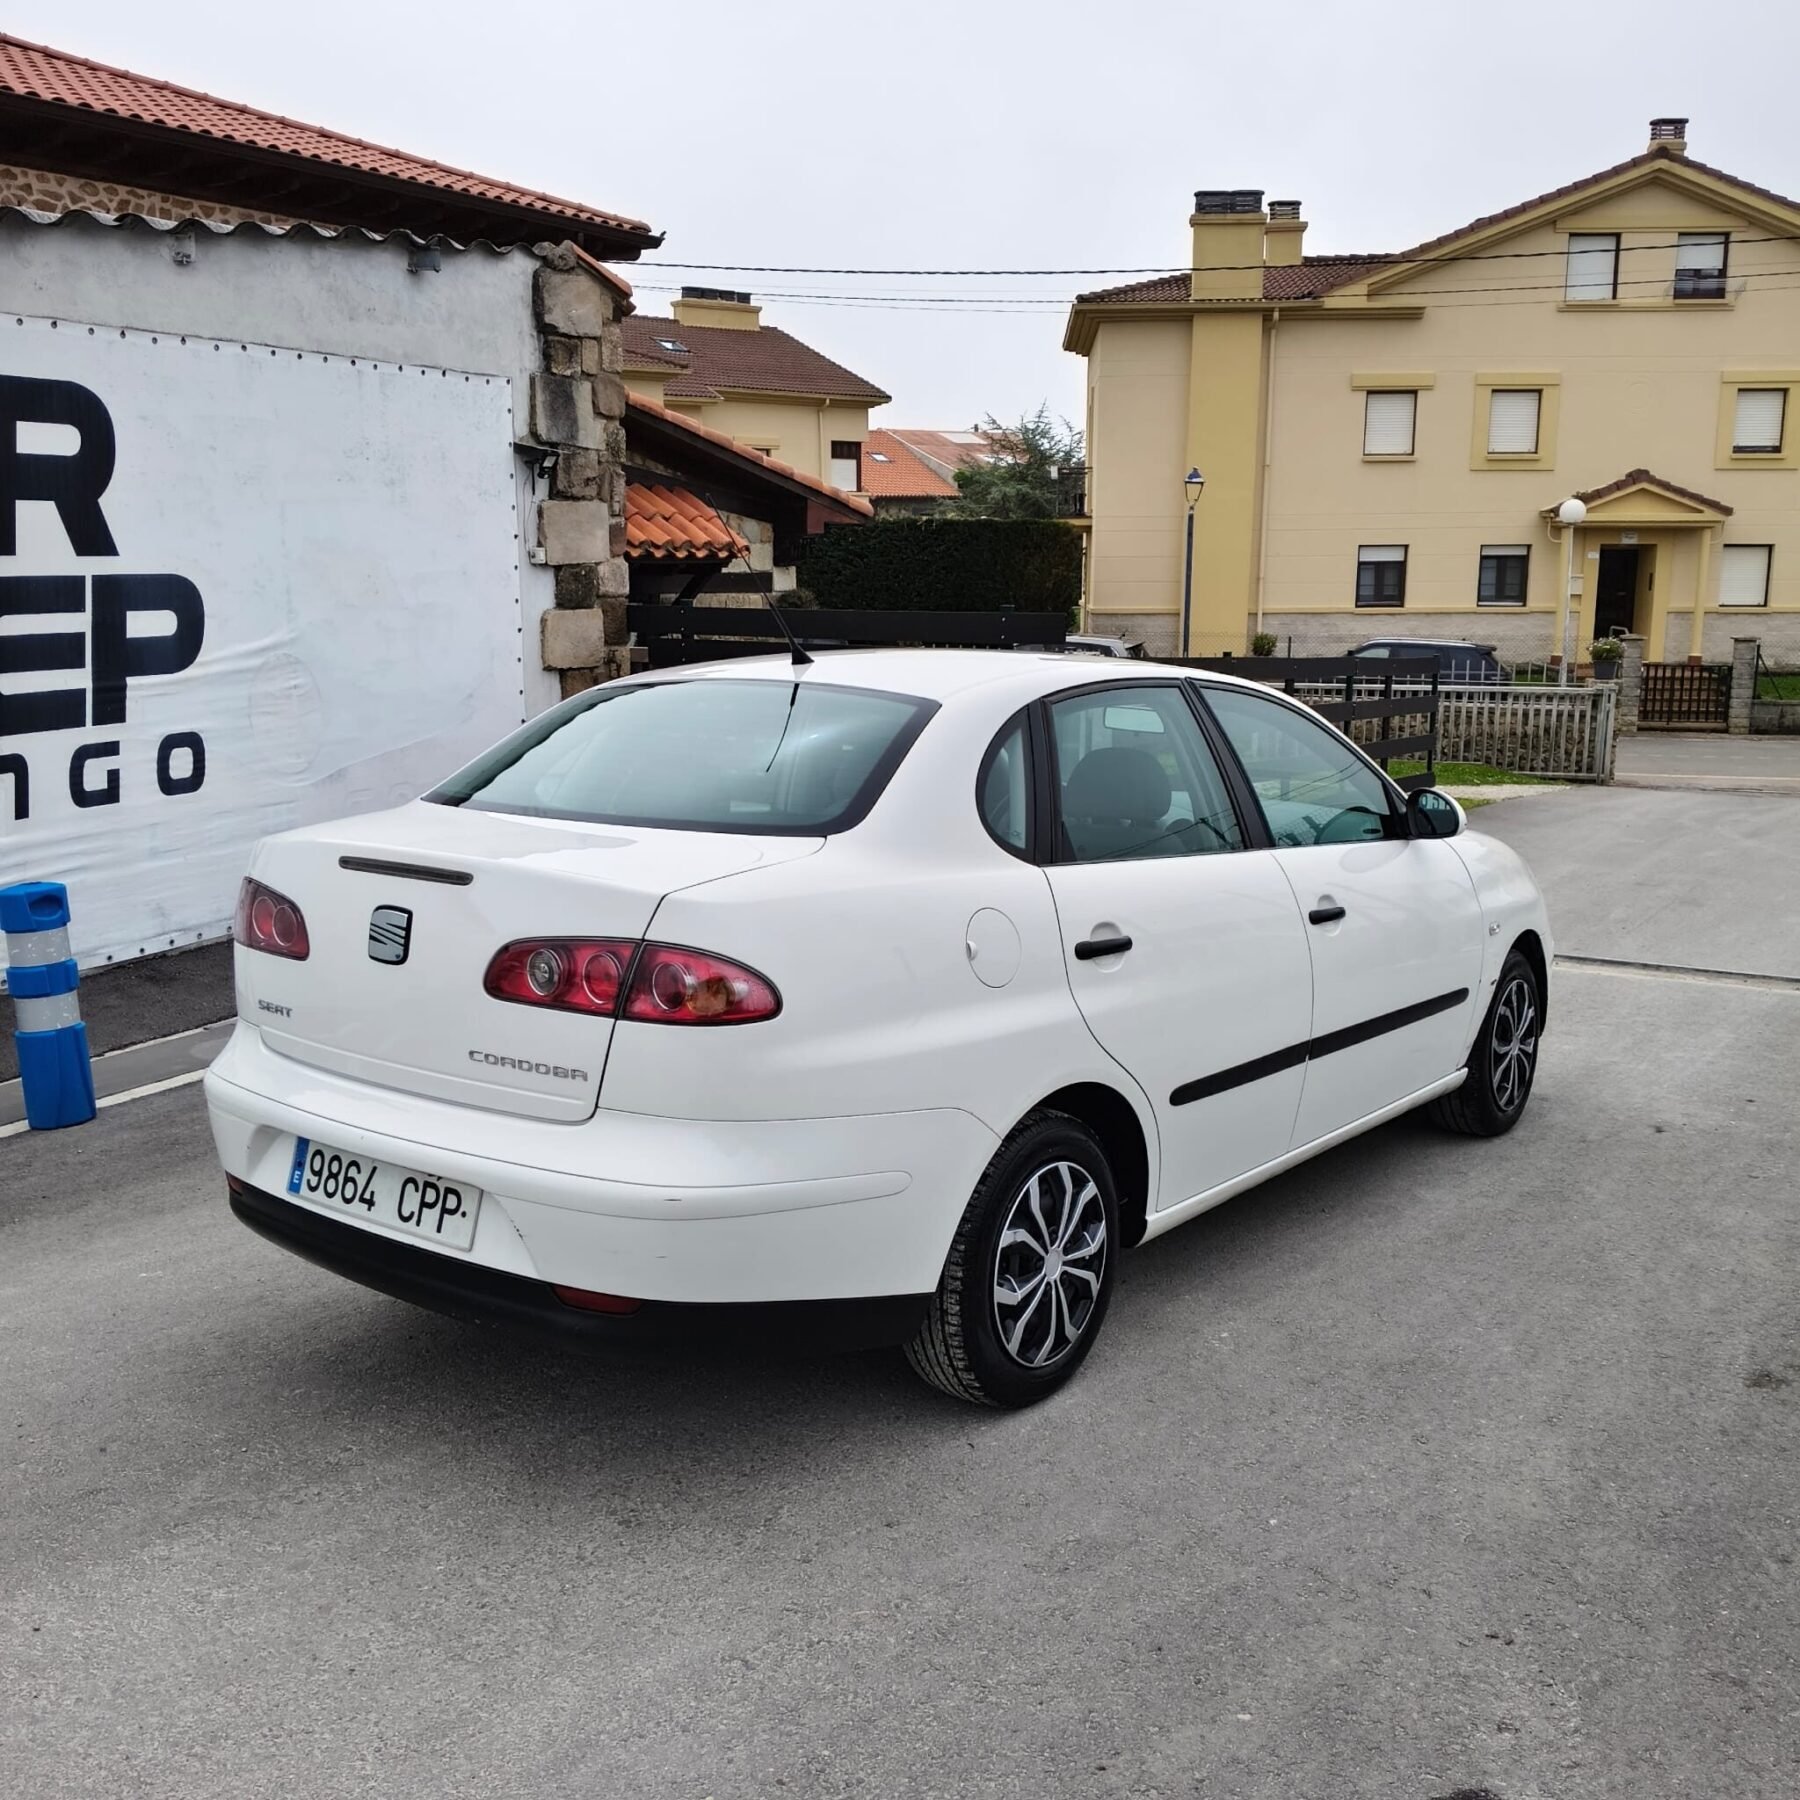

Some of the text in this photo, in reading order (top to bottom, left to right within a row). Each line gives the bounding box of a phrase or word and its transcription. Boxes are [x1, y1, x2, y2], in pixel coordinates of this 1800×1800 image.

[258, 999, 293, 1018] SEAT
[468, 1049, 588, 1082] CORDOBA
[306, 1149, 462, 1234] 9864 CPP
